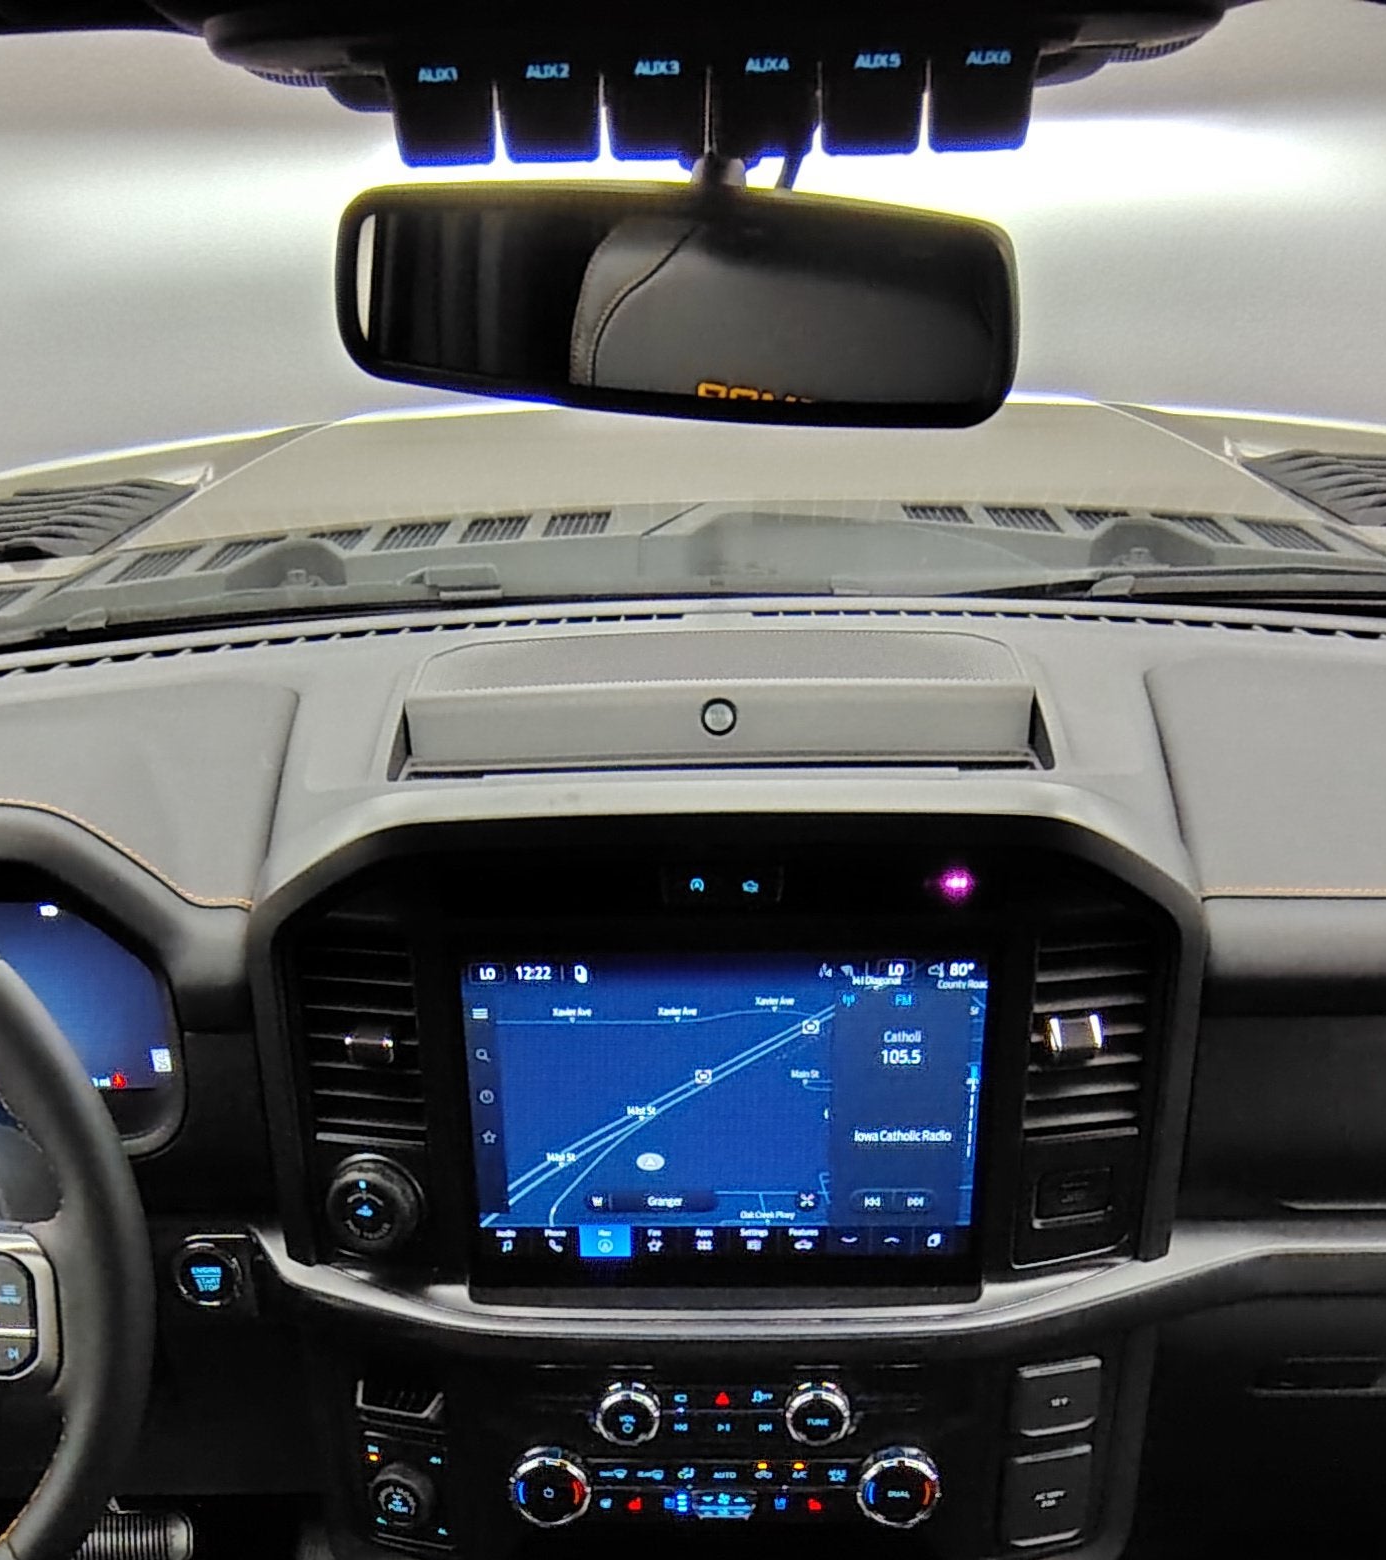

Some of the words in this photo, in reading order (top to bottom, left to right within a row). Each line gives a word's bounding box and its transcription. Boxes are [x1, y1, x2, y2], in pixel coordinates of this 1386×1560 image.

[479, 967, 496, 981] LO
[515, 966, 552, 981] 12:22
[888, 963, 904, 976] LO
[880, 1050, 921, 1065] 105.5
[880, 1129, 921, 1142] Catholic
[922, 1129, 953, 1142] Radio
[646, 1196, 684, 1208] Granger
[713, 1471, 737, 1479] AUTO
